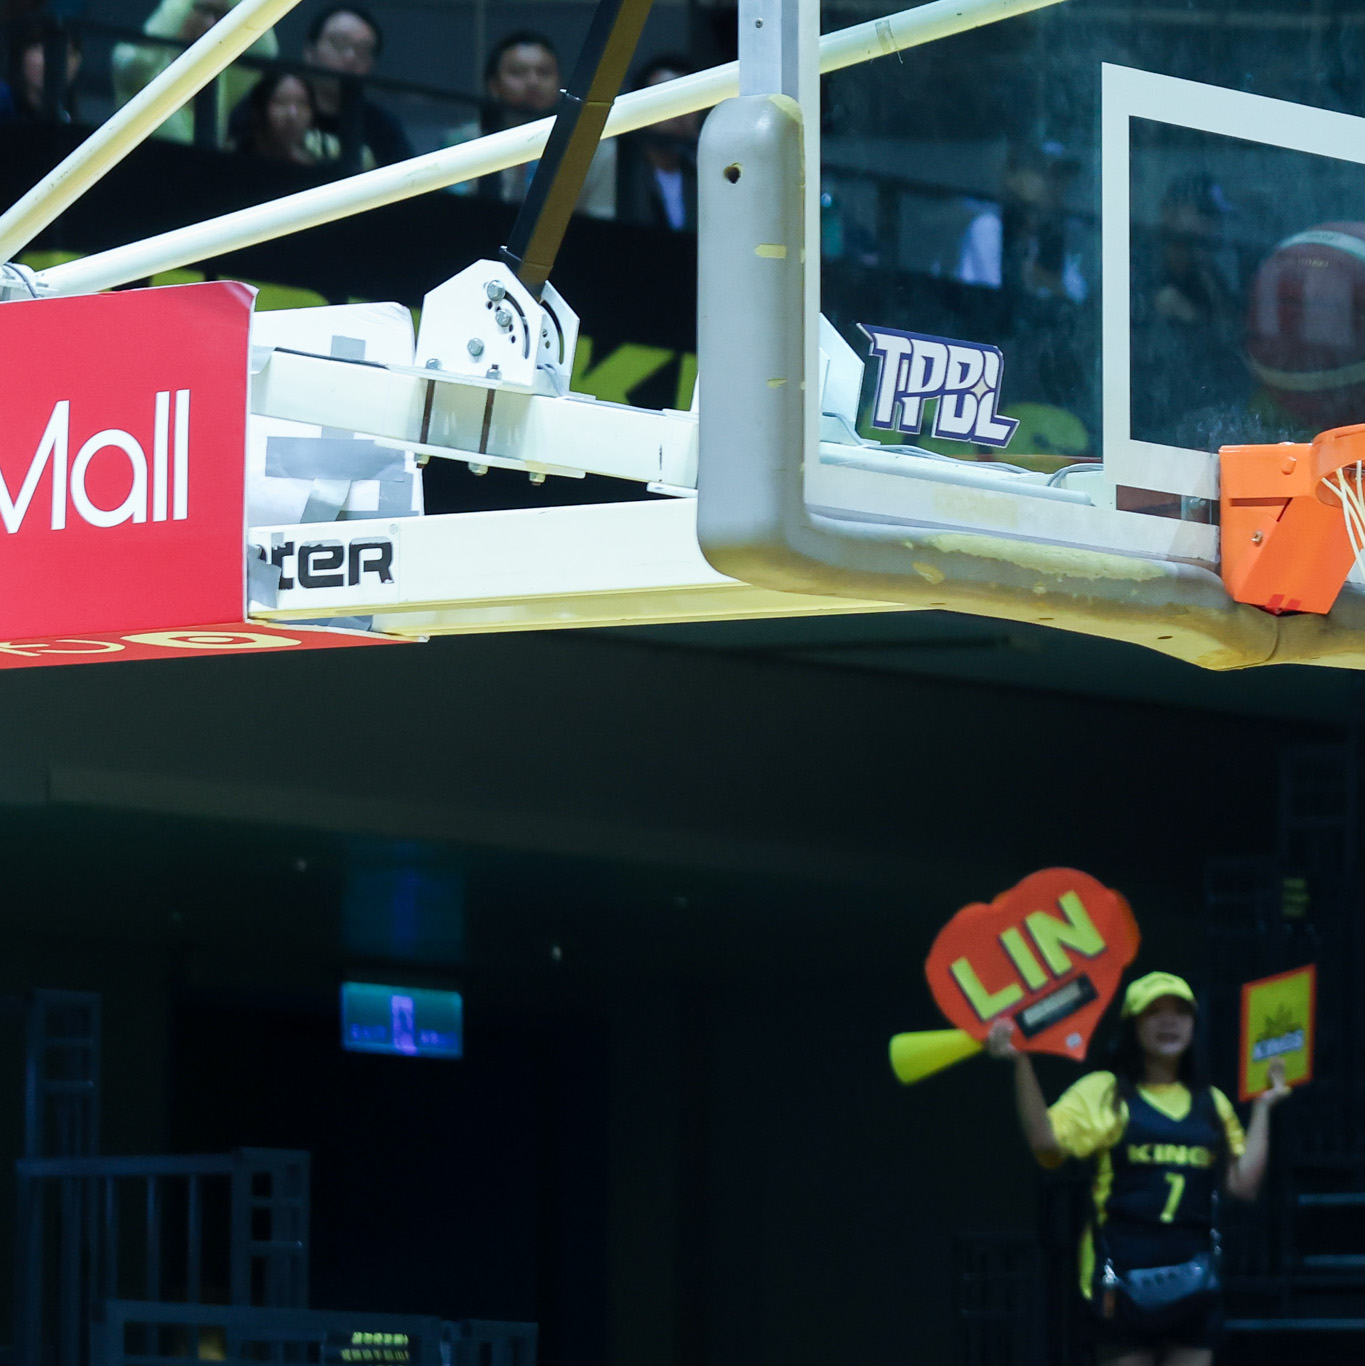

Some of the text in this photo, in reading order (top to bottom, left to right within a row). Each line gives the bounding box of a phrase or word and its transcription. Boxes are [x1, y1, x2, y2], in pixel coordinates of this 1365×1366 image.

[862, 325, 1018, 446] TPBL
[949, 890, 1107, 1022] LIN
[1159, 1172, 1186, 1224] 7
